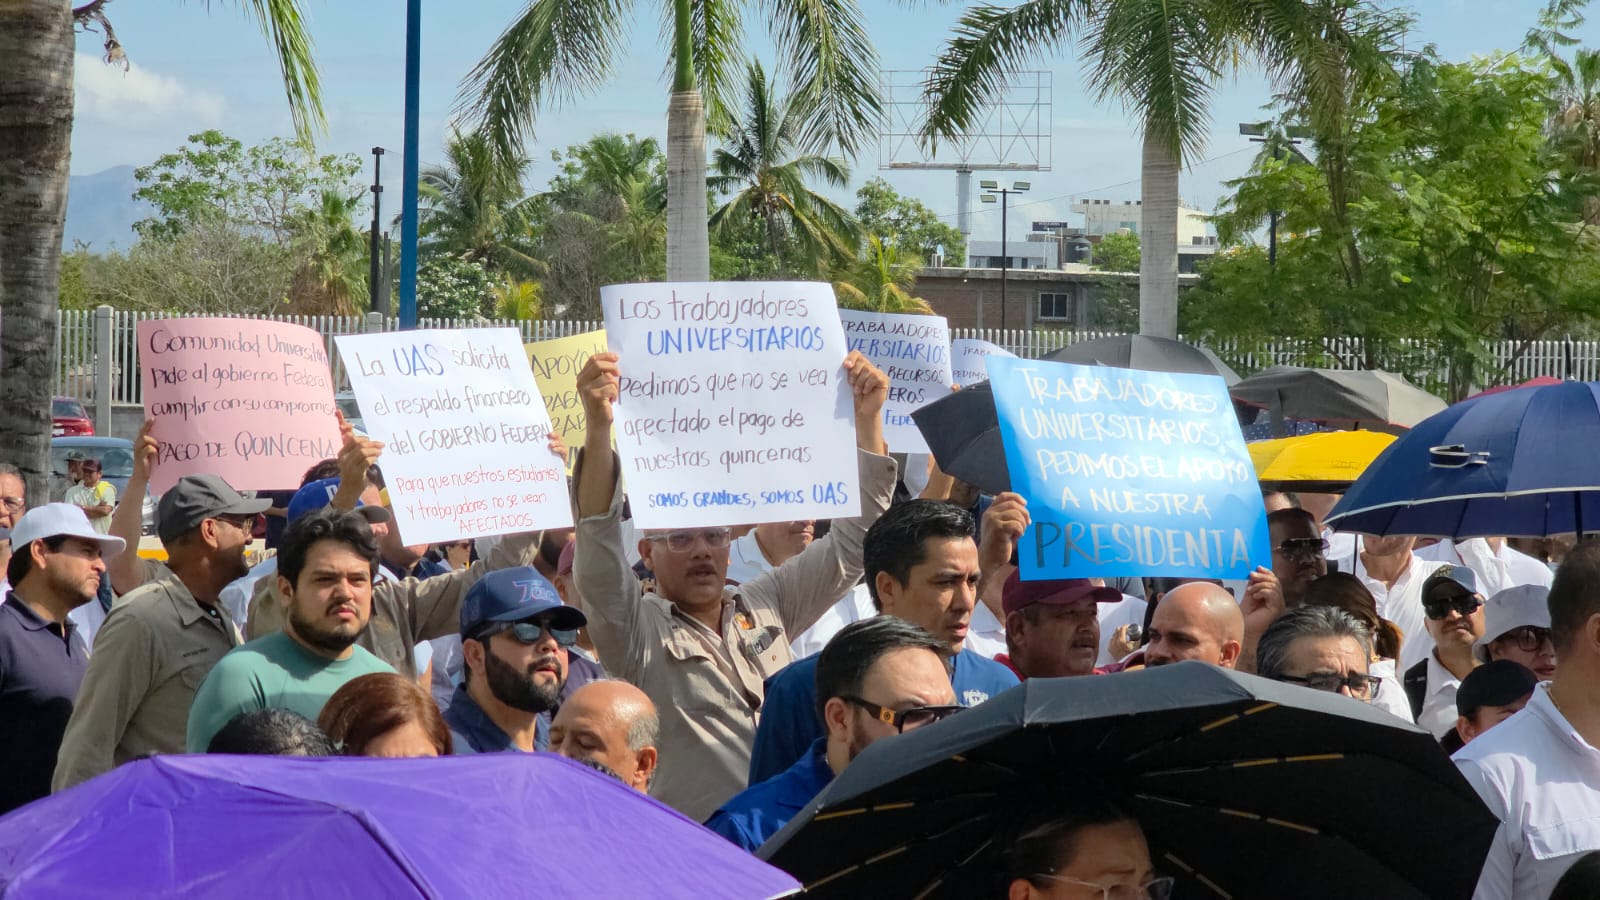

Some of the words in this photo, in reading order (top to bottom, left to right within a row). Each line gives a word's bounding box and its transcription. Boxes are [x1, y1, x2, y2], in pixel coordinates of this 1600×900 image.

[619, 297, 661, 320] Los
[668, 289, 809, 325] trabajadores
[647, 325, 825, 356] UNIVERSITARIOS
[846, 336, 947, 366] VERSITARIOS
[355, 351, 386, 377] La
[392, 344, 445, 377] UAS
[451, 341, 511, 371] solicita
[887, 365, 944, 384] RECURSOS
[952, 369, 986, 381] PEDIMO
[192, 363, 207, 383] al
[212, 363, 279, 389] gobierno
[283, 363, 330, 391] Federal
[706, 371, 737, 400] que
[741, 370, 764, 390] no
[769, 370, 789, 389] se
[799, 367, 828, 387] vea
[1013, 367, 1217, 414] TRABAJADORES
[151, 396, 210, 421] cumplir
[213, 399, 241, 412] con
[244, 399, 260, 411] su
[374, 397, 391, 416] el
[395, 388, 461, 418] respaldo
[464, 385, 531, 413] financiero
[884, 409, 917, 426] FEDE
[389, 429, 416, 456] del
[418, 421, 497, 449] GOBIERNO
[623, 407, 711, 446] afectado
[718, 407, 735, 428] el
[738, 411, 776, 435] pago
[781, 408, 805, 428] de
[157, 441, 201, 466] PAGO
[205, 442, 227, 458] DE
[234, 430, 337, 462] QUINCENA
[633, 447, 711, 473] nuestras
[719, 446, 812, 473] quincenas
[427, 474, 450, 495] que
[451, 464, 505, 487] nuestros
[507, 463, 560, 484] estudiantes
[1036, 448, 1140, 481] PEDIMOS
[1140, 452, 1169, 478] EL
[1177, 454, 1249, 485] APOYO
[418, 495, 488, 522] trabajadores
[492, 496, 505, 509] no
[506, 494, 519, 508] se
[522, 491, 548, 505] vean
[648, 491, 689, 508] SOMOS
[759, 489, 805, 505] SOMOS
[812, 481, 848, 505] UAS
[1061, 486, 1081, 510] A
[1089, 487, 1213, 520] NUESTRA
[459, 512, 534, 534] AFECTADOS
[1034, 520, 1251, 570] PRESIDENTA
